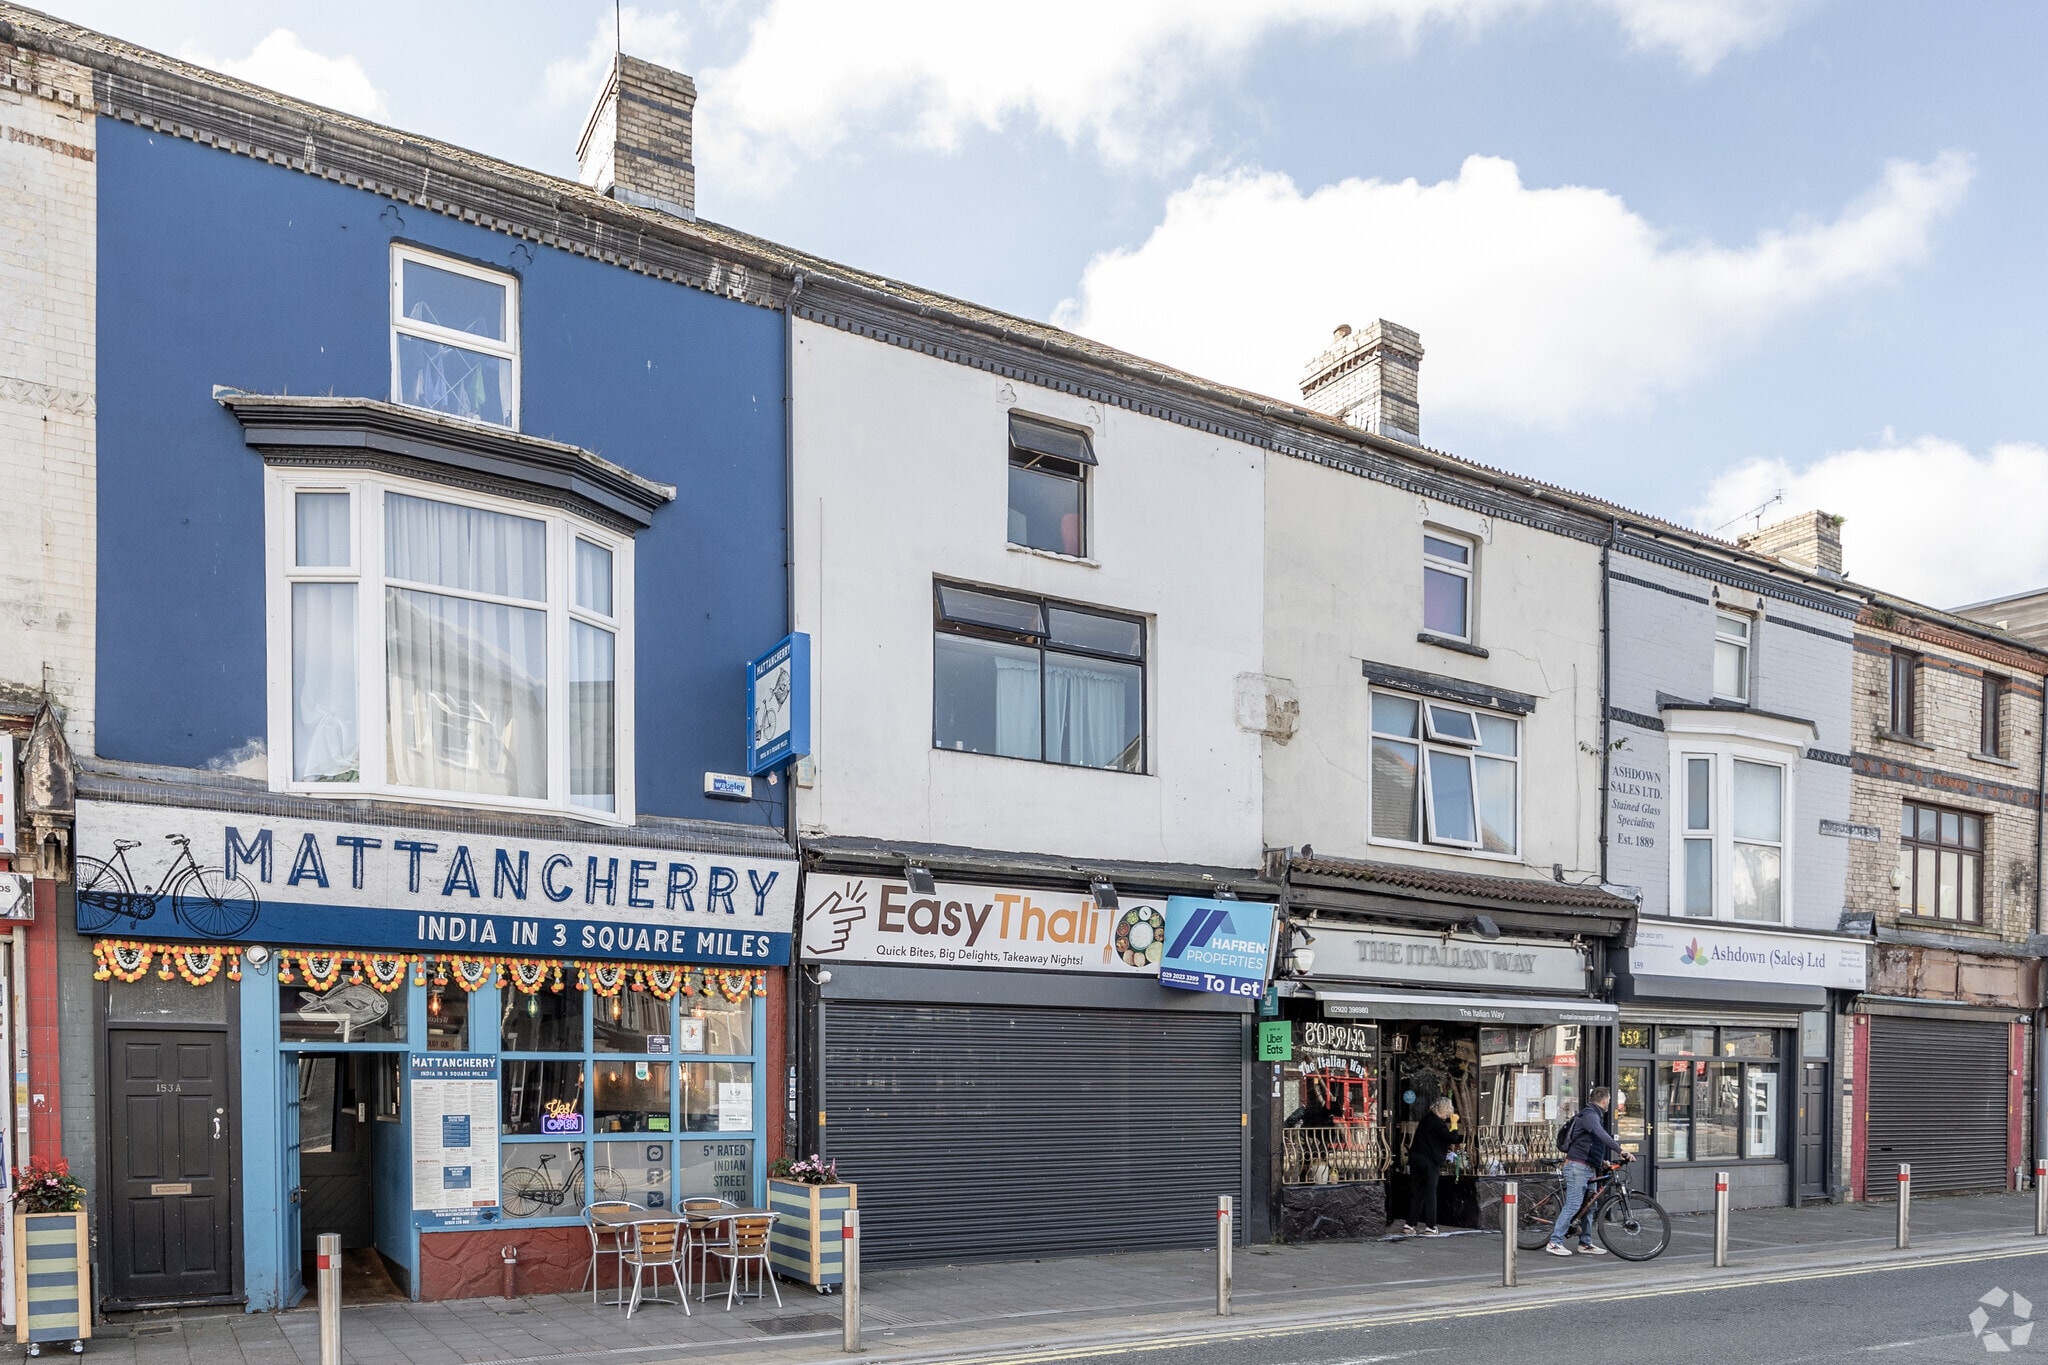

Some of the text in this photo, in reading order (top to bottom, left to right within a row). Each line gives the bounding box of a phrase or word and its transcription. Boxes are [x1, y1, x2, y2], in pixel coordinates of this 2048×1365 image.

[1612, 766, 1661, 784] ASHDOWN
[1611, 781, 1663, 800] SALES LTD.
[1611, 798, 1661, 816] Stained Glass
[1617, 814, 1655, 829] Specialists
[1617, 832, 1655, 848] Est. 1889
[225, 826, 779, 916] MATTANCHERRY
[418, 915, 770, 958] INDIA IN 3 SQUARE MILES
[1211, 937, 1266, 954] HAFREN
[876, 945, 1084, 967] Quick Bites, Big Delights, Takeaway Nights!
[1187, 950, 1264, 969] PROPERTIES
[1356, 939, 1538, 974] THE ITALIAN WAY
[1711, 944, 1766, 964] Ashdown
[1769, 949, 1804, 971] (Sales)
[1807, 952, 1825, 968] Ltd
[1634, 961, 1644, 969] 159
[1203, 974, 1225, 992] To
[1230, 977, 1260, 997] Let
[1459, 1008, 1505, 1020] The Italian Way
[1266, 1034, 1283, 1044] Uber
[1621, 1030, 1641, 1046] 159
[1266, 1045, 1283, 1055] Eats
[412, 1057, 496, 1068] MATTANCHERRY
[1298, 1056, 1367, 1079] The Italian Way
[156, 1083, 182, 1093] 153A
[546, 1099, 578, 1118] Yes!
[547, 1119, 579, 1130] OPEN
[717, 1144, 746, 1156] RATED
[714, 1160, 746, 1172] INDIAN
[713, 1175, 746, 1187] STREET
[722, 1190, 746, 1202] FOOD
